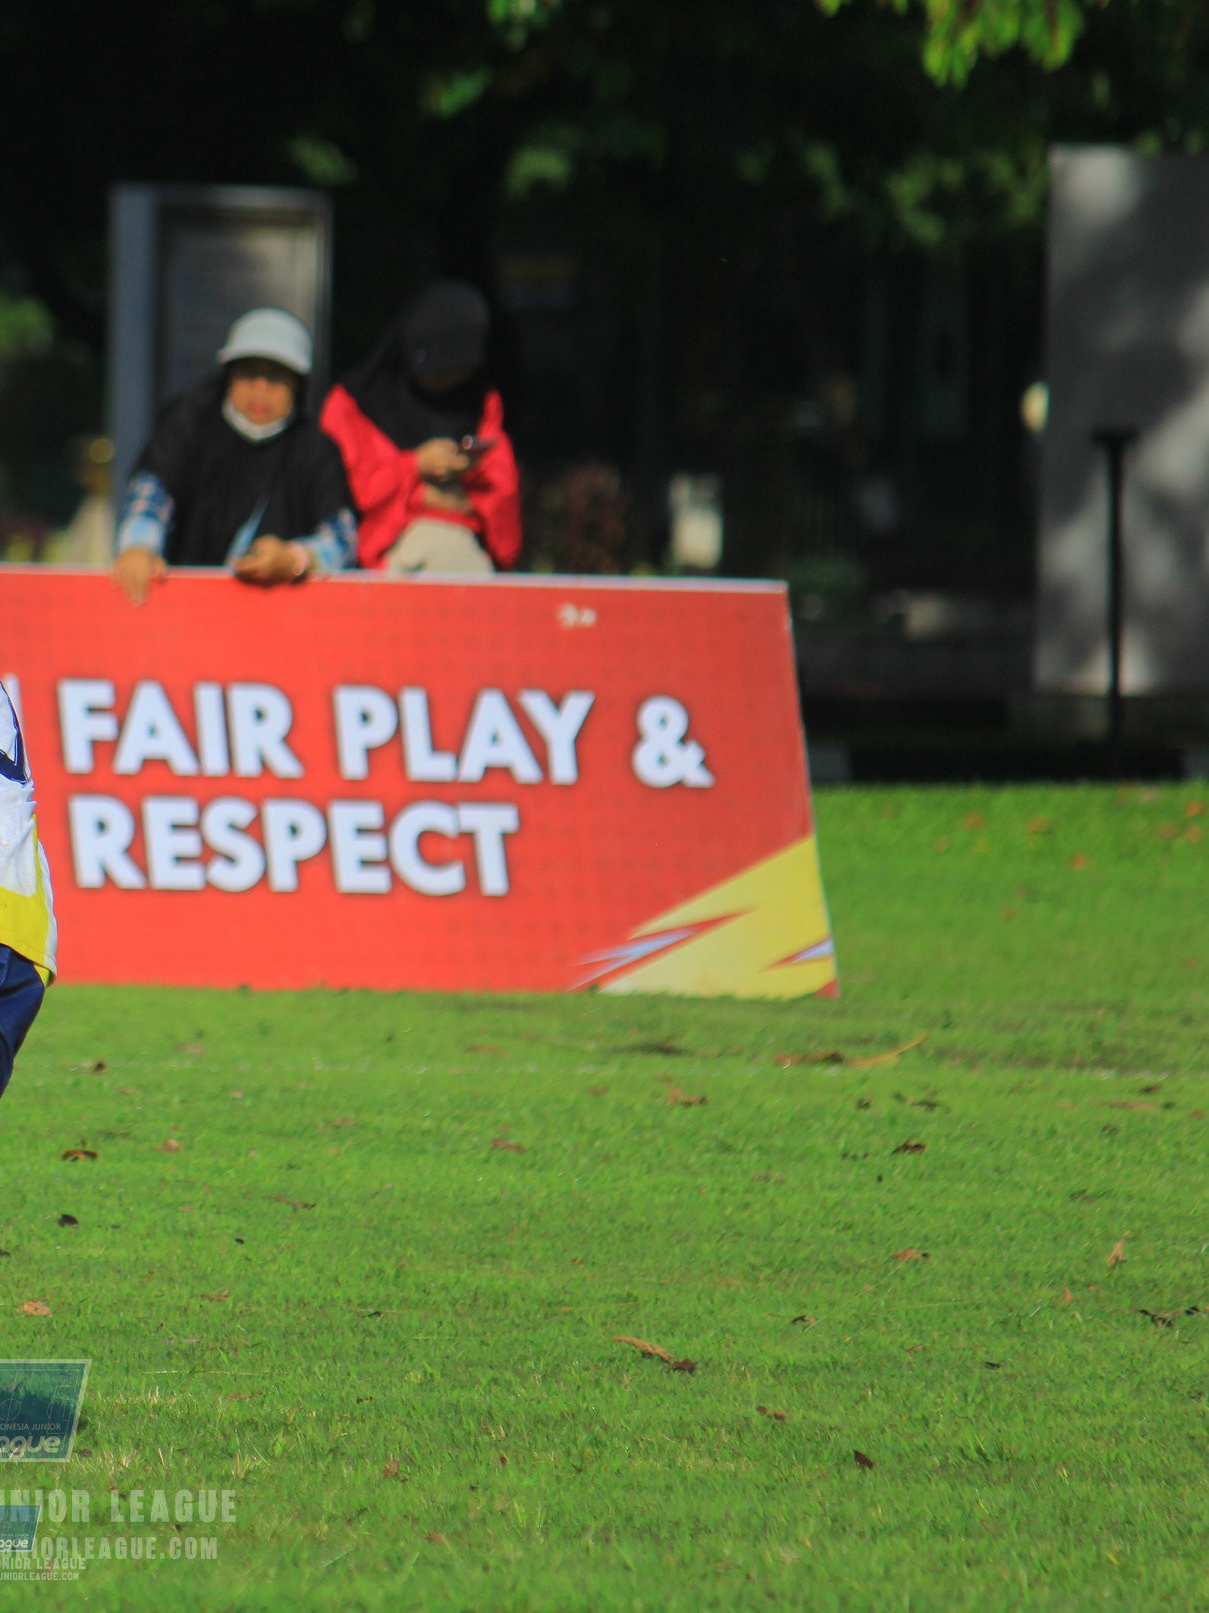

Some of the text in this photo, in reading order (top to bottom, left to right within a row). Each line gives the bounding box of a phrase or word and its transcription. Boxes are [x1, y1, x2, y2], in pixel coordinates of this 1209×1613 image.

[57, 678, 304, 779] FAIR
[333, 684, 596, 785] PLAY
[631, 695, 716, 789] &
[69, 794, 521, 897] RESPECT
